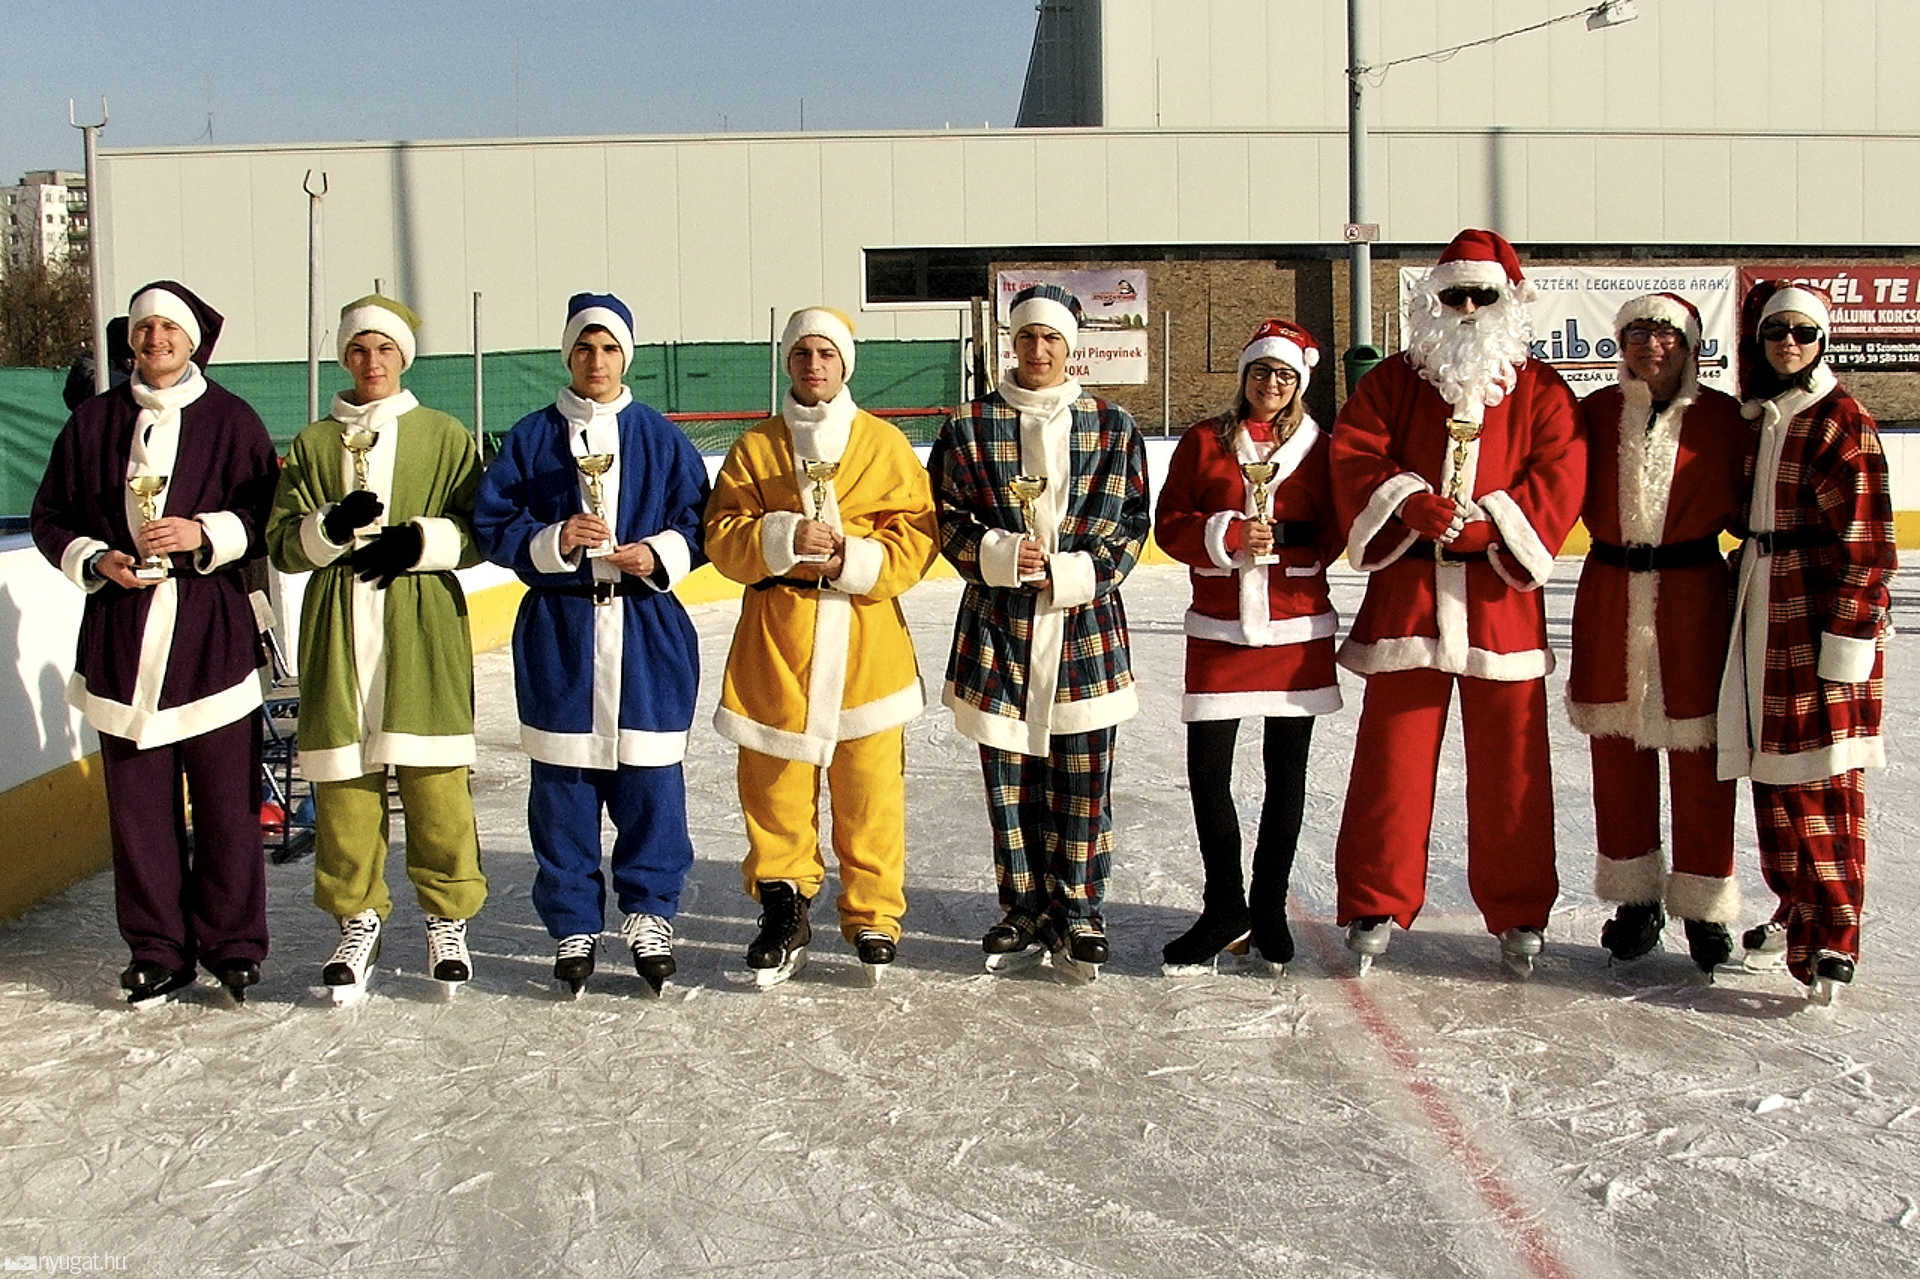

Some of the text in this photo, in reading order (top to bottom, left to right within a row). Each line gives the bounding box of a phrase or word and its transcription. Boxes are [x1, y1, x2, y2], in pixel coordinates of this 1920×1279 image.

[1873, 278, 1910, 304] TE
[1088, 347, 1142, 361] Pingvinek
[1065, 364, 1090, 377] OKA
